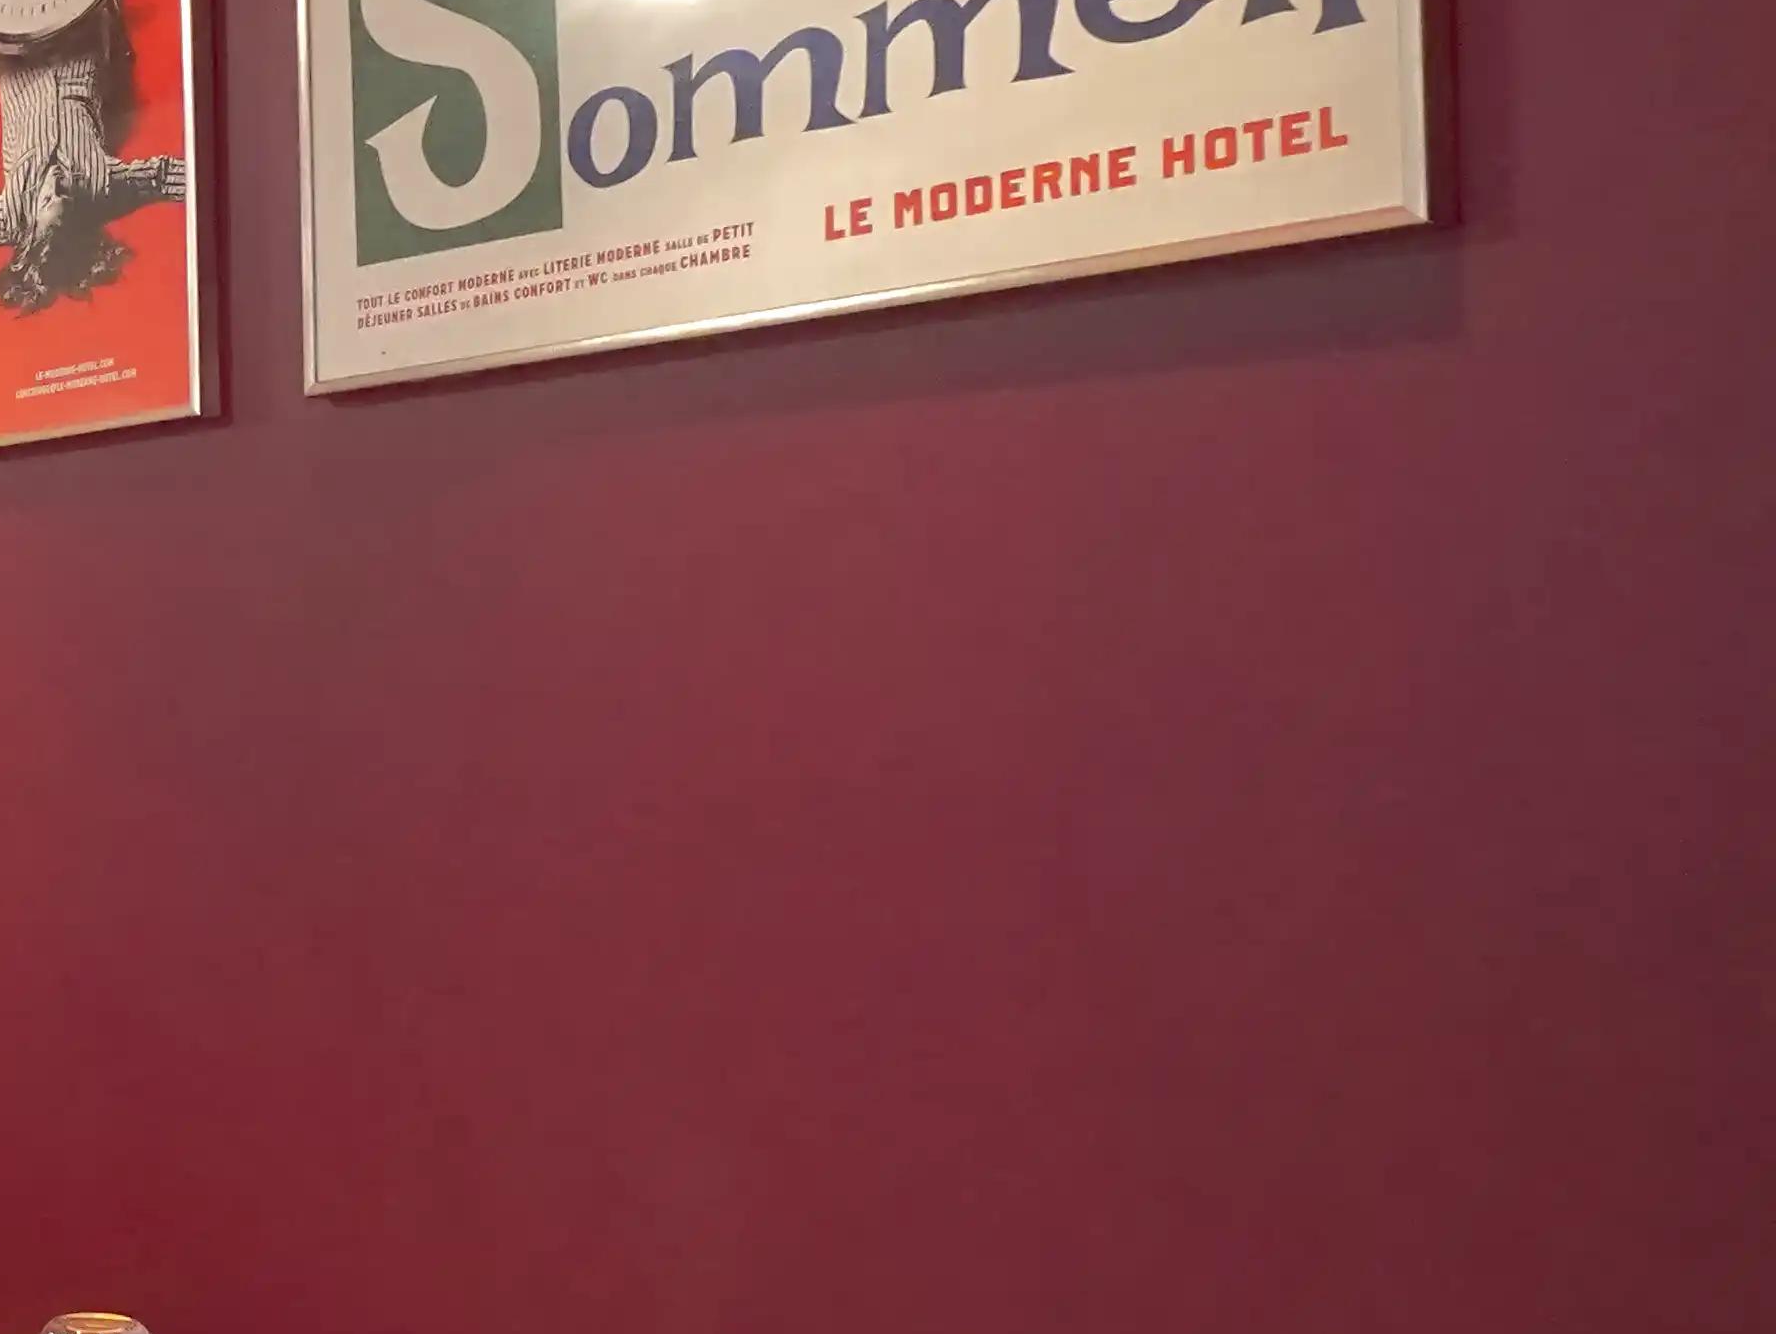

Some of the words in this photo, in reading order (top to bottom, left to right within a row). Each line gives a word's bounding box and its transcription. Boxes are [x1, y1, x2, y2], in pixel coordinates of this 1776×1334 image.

[823, 190, 873, 242] LE
[892, 144, 1136, 230] MODERNE
[1162, 103, 1348, 180] HOTEL
[357, 295, 384, 312] TOUT
[388, 291, 401, 305] LE
[405, 281, 454, 302] CONFORT
[458, 269, 514, 292] MODERNE
[543, 253, 593, 275] LITERIE
[597, 239, 661, 265] MODERNE
[712, 221, 754, 242] PETIT
[417, 299, 458, 319] SALLES
[473, 289, 510, 308] BAINS
[513, 278, 571, 300] CONFORT
[588, 271, 608, 287] WC
[680, 244, 751, 269] CHAMBRE
